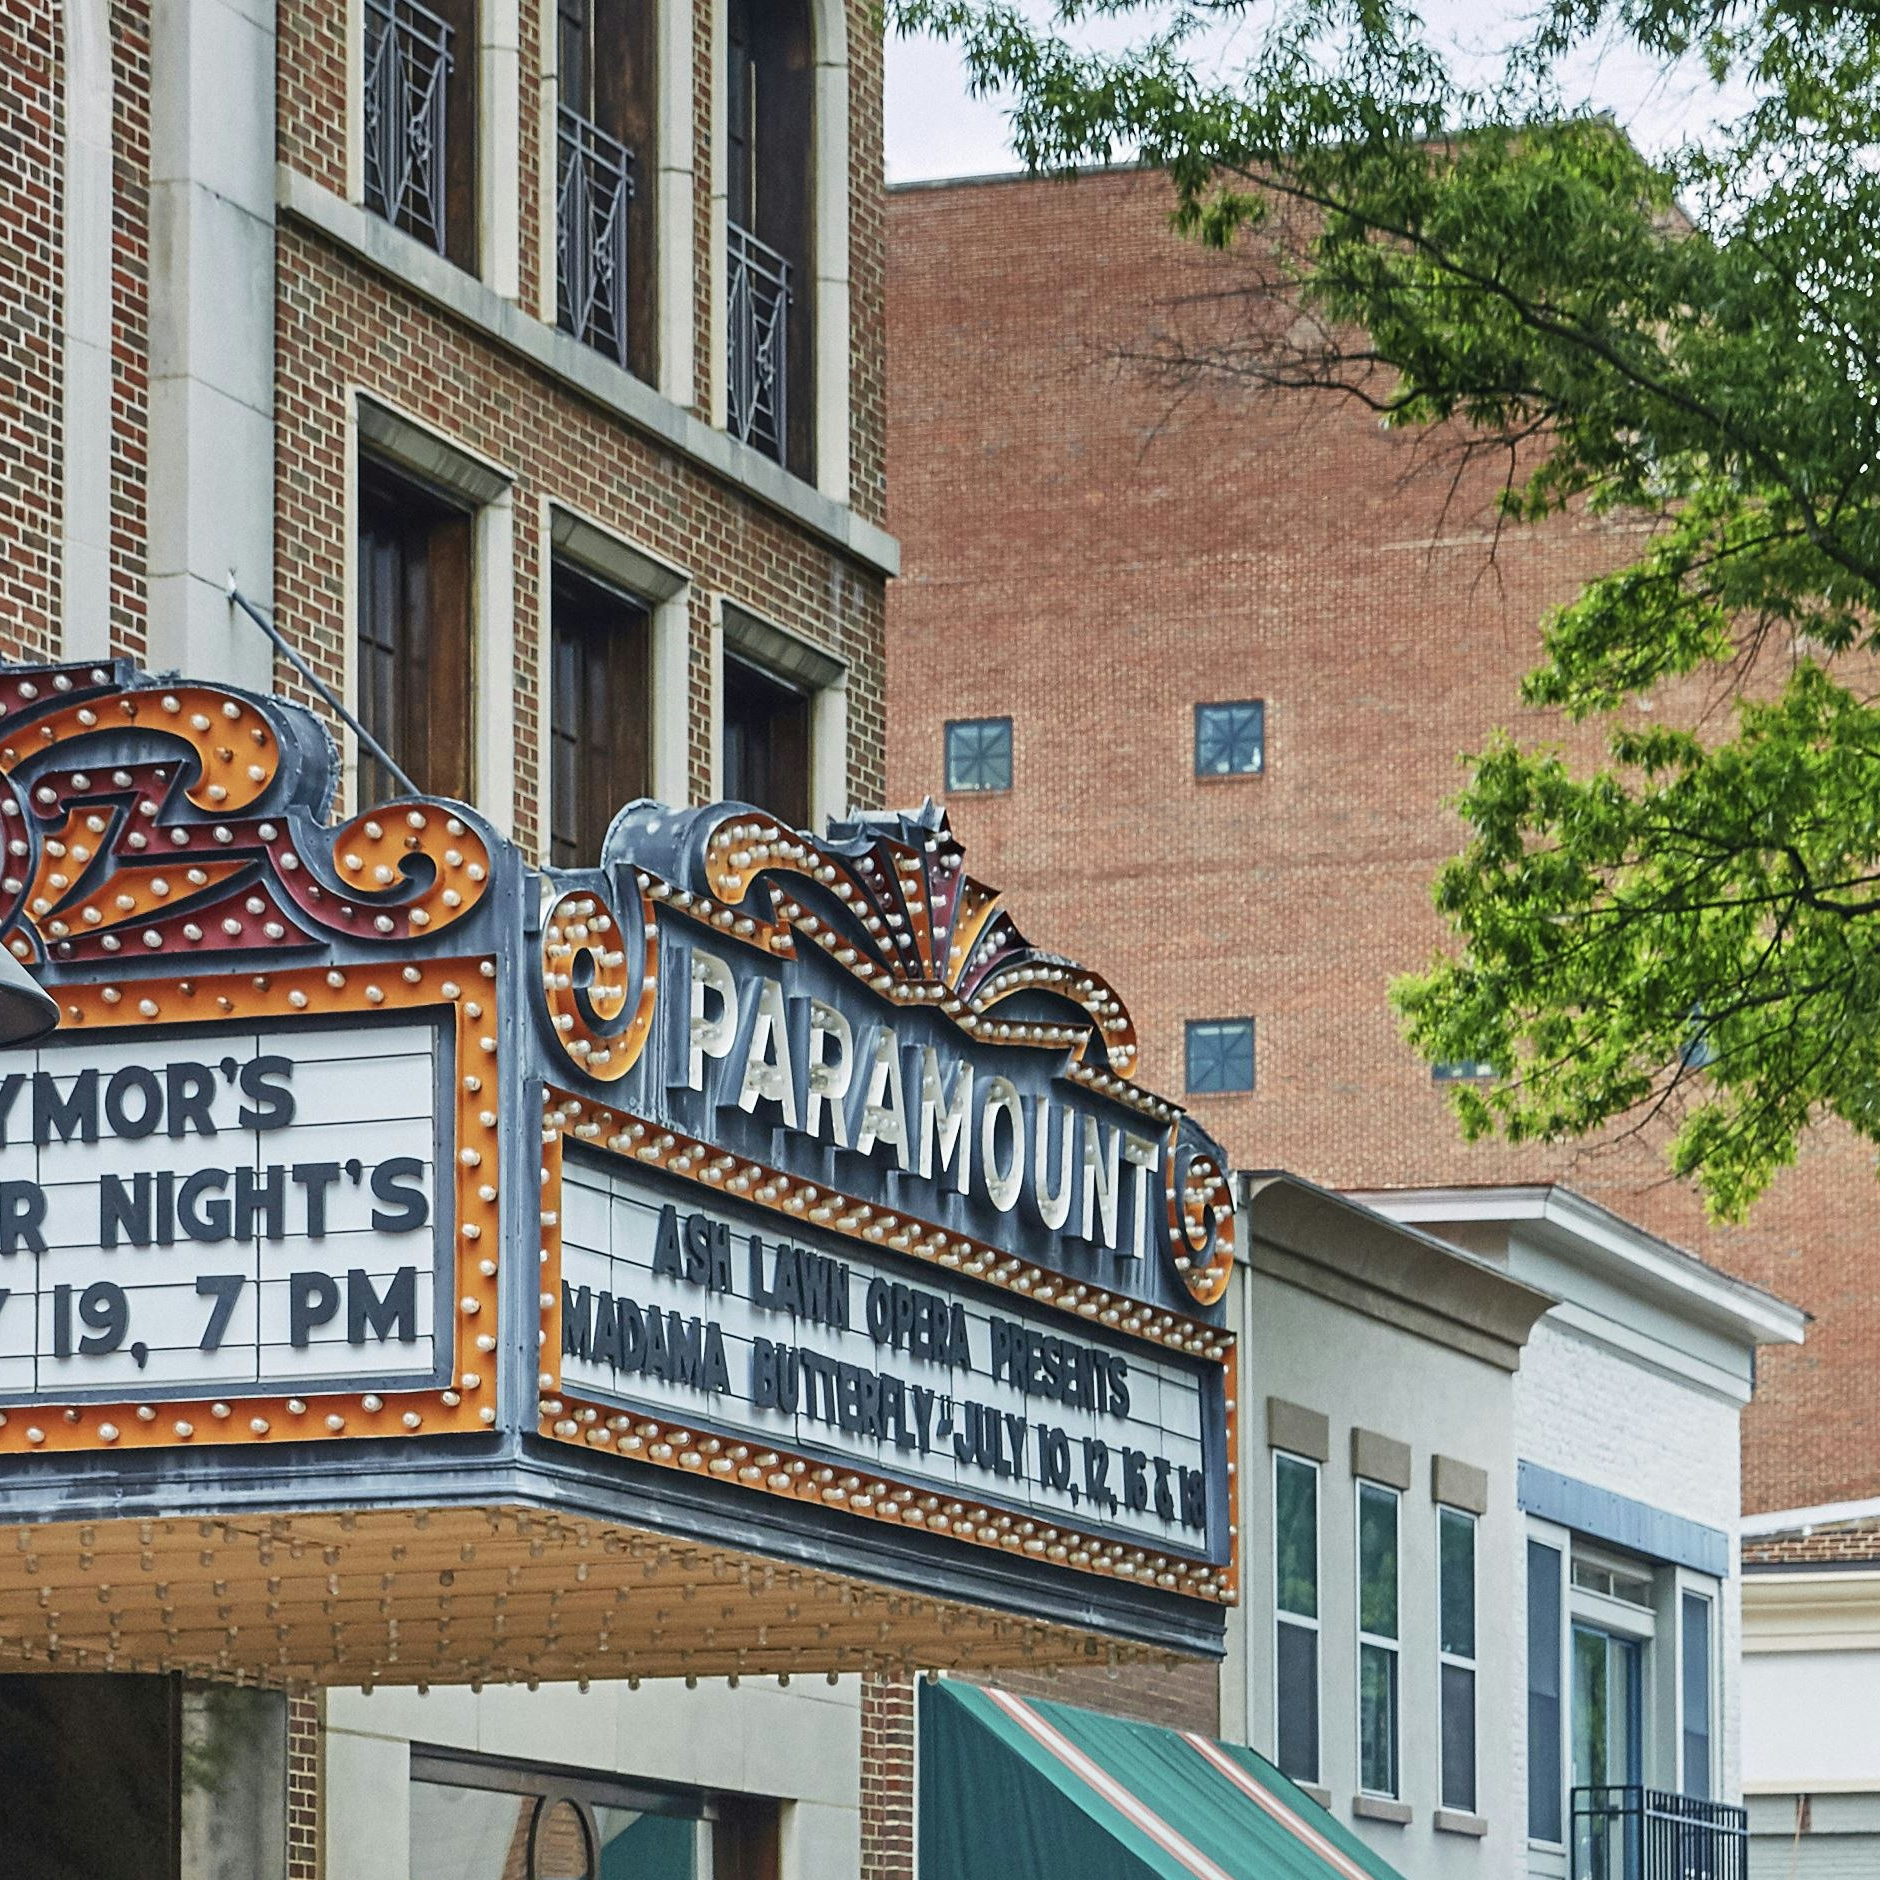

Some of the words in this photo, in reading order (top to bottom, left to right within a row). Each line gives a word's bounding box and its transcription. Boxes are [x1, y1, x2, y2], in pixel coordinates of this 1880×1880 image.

[99, 1156, 430, 1249] NIGHT'S
[681, 943, 1162, 1261] PARAMOUNT
[53, 1280, 150, 1370] 19,
[195, 1274, 247, 1351] 7
[291, 1265, 418, 1349] PM
[561, 1278, 731, 1396] MADAMA
[1038, 1423, 1079, 1507] 10,
[1083, 1437, 1118, 1518] 12,
[1122, 1446, 1148, 1511] 16
[1154, 1456, 1175, 1521] &
[1179, 1465, 1206, 1529] 18
[652, 1203, 732, 1295] ASH
[749, 1232, 851, 1333] LAWN
[866, 1276, 972, 1372] OPERA
[989, 1313, 1130, 1419] PRESENTS
